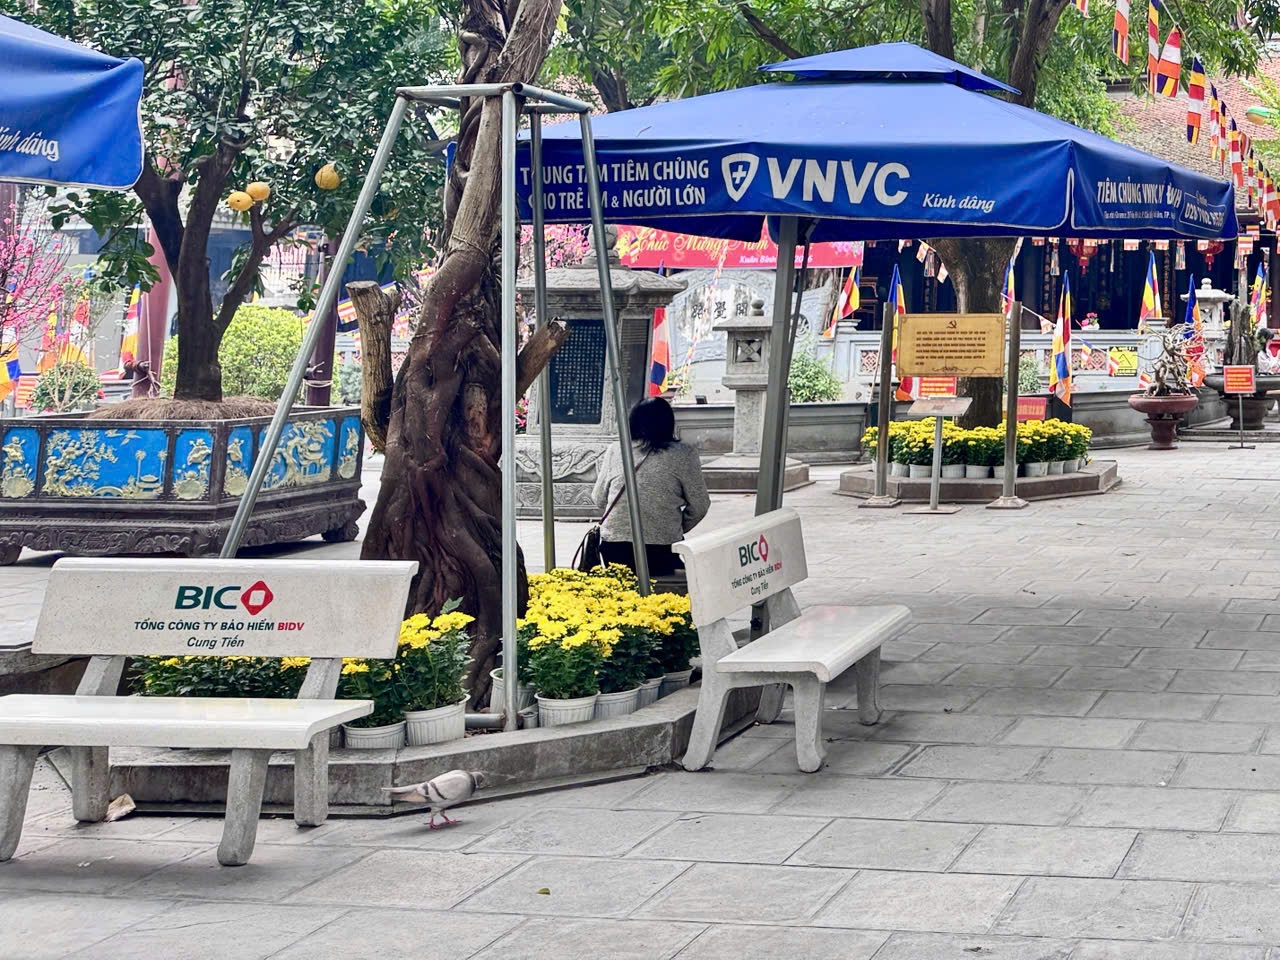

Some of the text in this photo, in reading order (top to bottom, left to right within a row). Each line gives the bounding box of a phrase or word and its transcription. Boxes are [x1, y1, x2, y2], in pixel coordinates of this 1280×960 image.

[16, 131, 59, 162] dâng
[520, 156, 710, 187] TUNG TM TIÊM CHỦNG
[767, 157, 911, 206] VNVC
[558, 187, 584, 210] TRẺ
[611, 195, 619, 208] &
[623, 184, 672, 208] NGƯỜI
[675, 183, 706, 206] LỚN
[922, 193, 996, 214] Kính dâng
[1097, 176, 1117, 204] TIÊM
[795, 254, 813, 264] 206
[168, 619, 201, 631] CÔNG
[203, 621, 218, 631] TY
[220, 619, 244, 631] BẢO
[277, 622, 305, 631] BIDV
[187, 634, 245, 650] Cung Tiến
